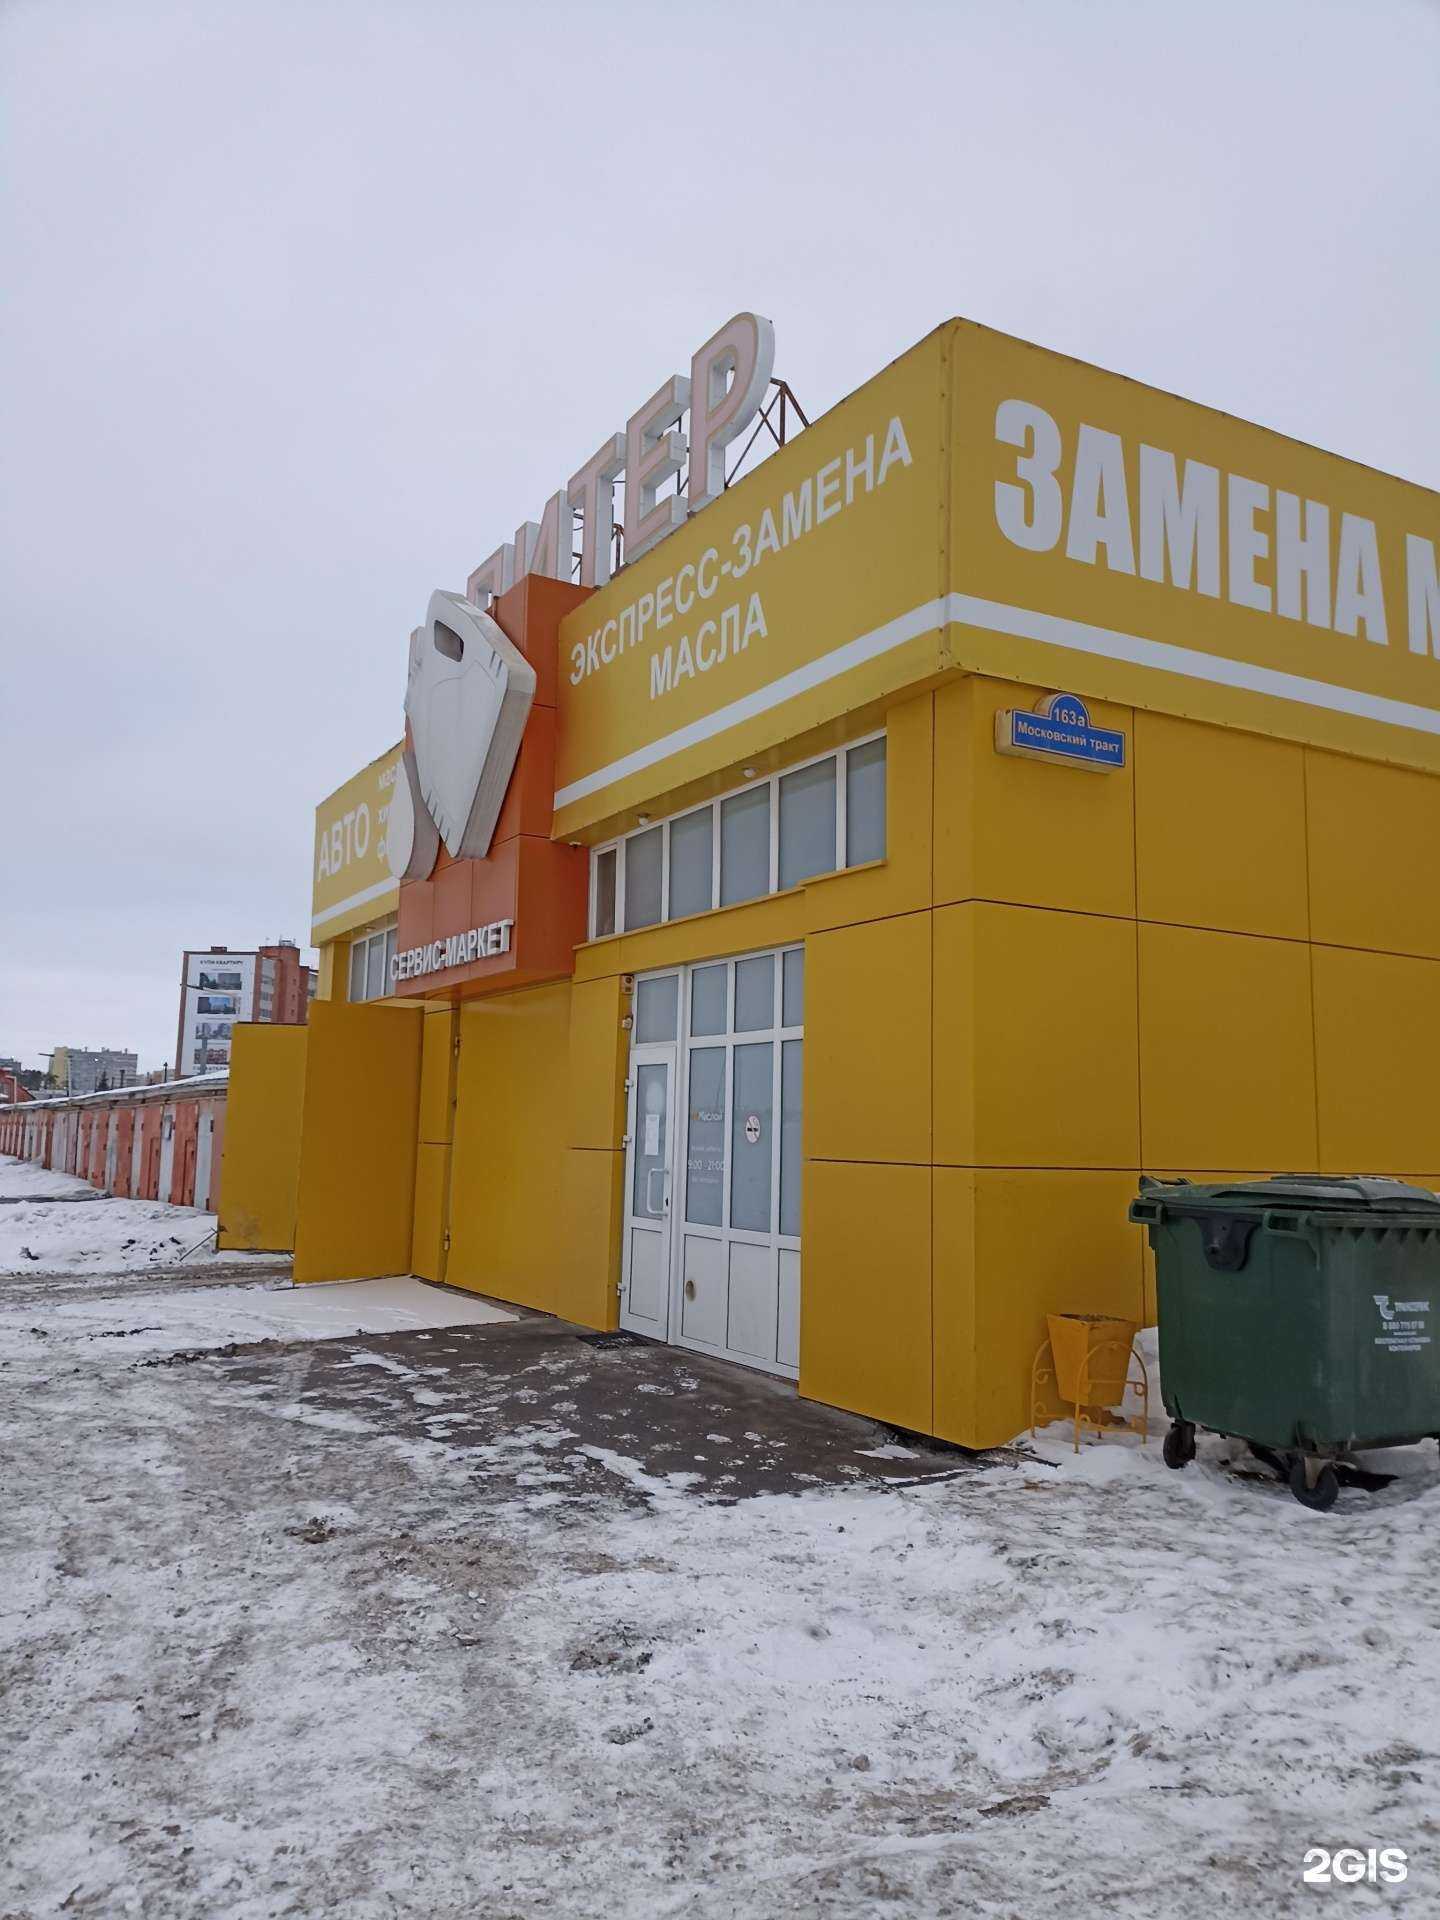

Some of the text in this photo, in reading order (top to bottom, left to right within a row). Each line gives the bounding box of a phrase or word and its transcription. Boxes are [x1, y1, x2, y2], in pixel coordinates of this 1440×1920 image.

[570, 415, 913, 686] ЭКСПРЕСС-ЗАМЕНА
[994, 398, 1389, 646] ЗАМЕНА
[650, 592, 768, 699] МАСЛА
[1018, 721, 1120, 753] Московский тракт
[1054, 707, 1085, 727] 163а
[317, 802, 370, 882] АВТО
[390, 918, 515, 980] СЕРВИС-МАРКЕТ
